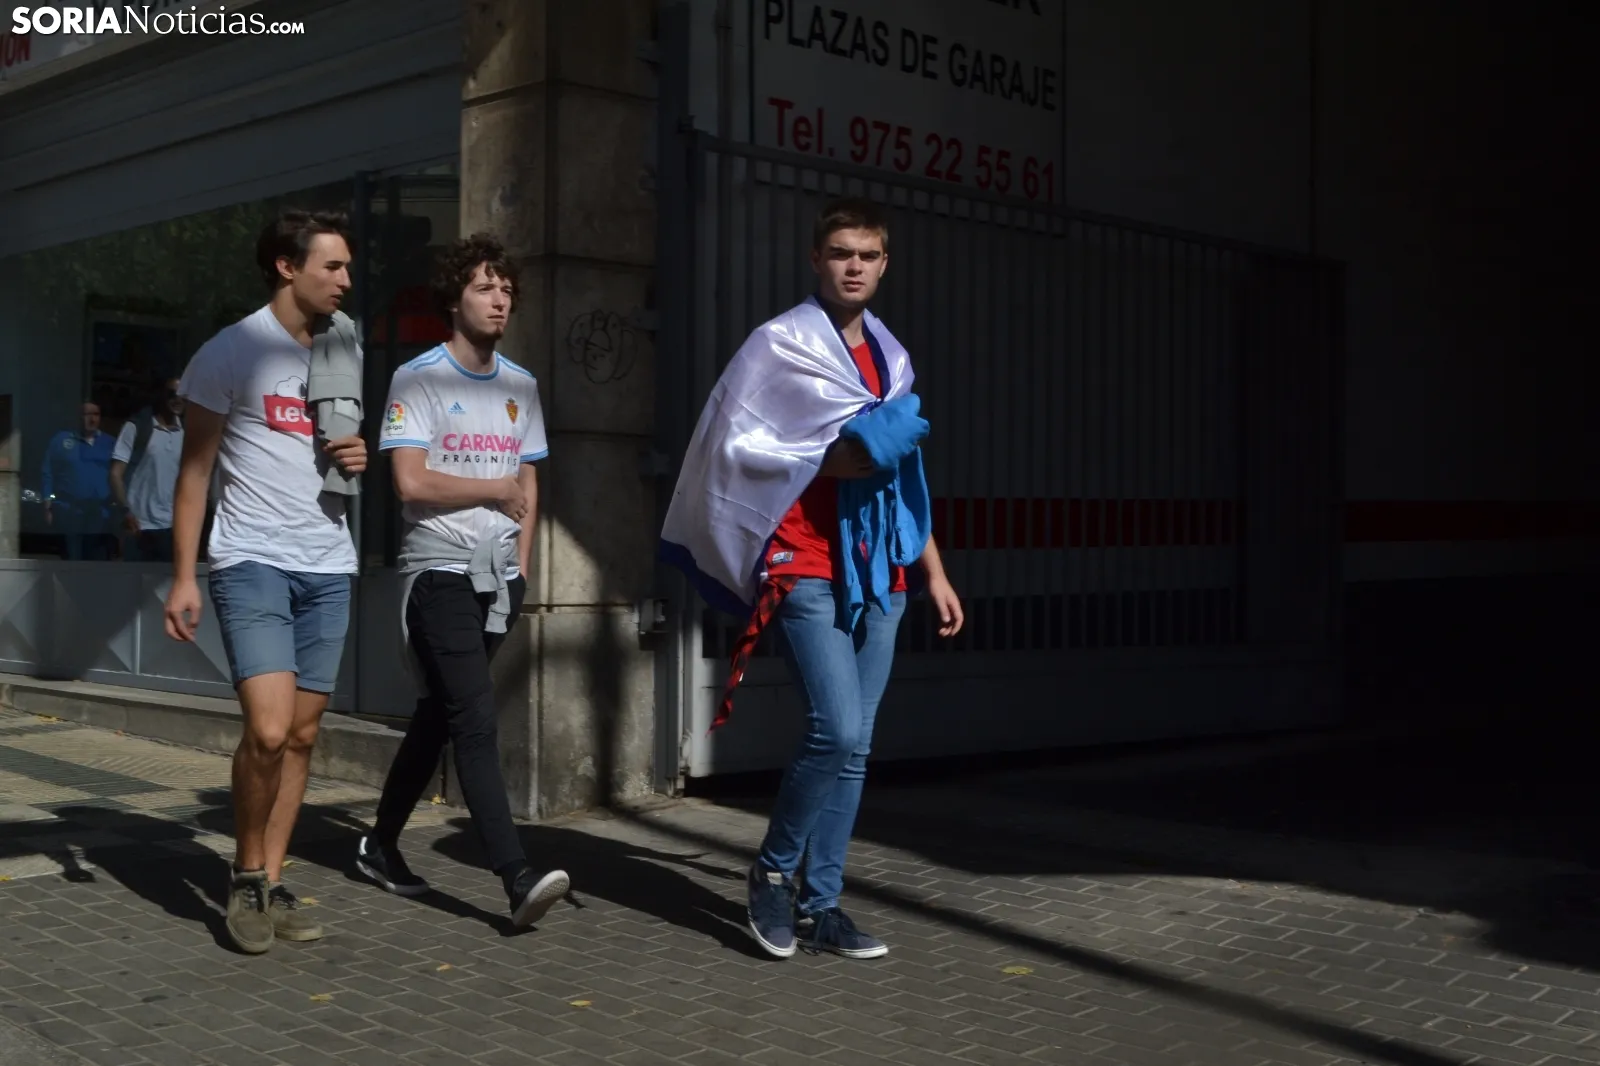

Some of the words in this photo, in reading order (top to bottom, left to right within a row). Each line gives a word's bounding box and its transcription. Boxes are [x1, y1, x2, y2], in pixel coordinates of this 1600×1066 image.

[764, 0, 889, 67] PLAZAS
[901, 28, 938, 80] DE
[949, 43, 1056, 111] GARAJE
[767, 97, 834, 157] Tel.
[849, 116, 912, 172] 975
[925, 133, 963, 183] 22
[975, 144, 1011, 193] 55
[1023, 156, 1054, 203] 61
